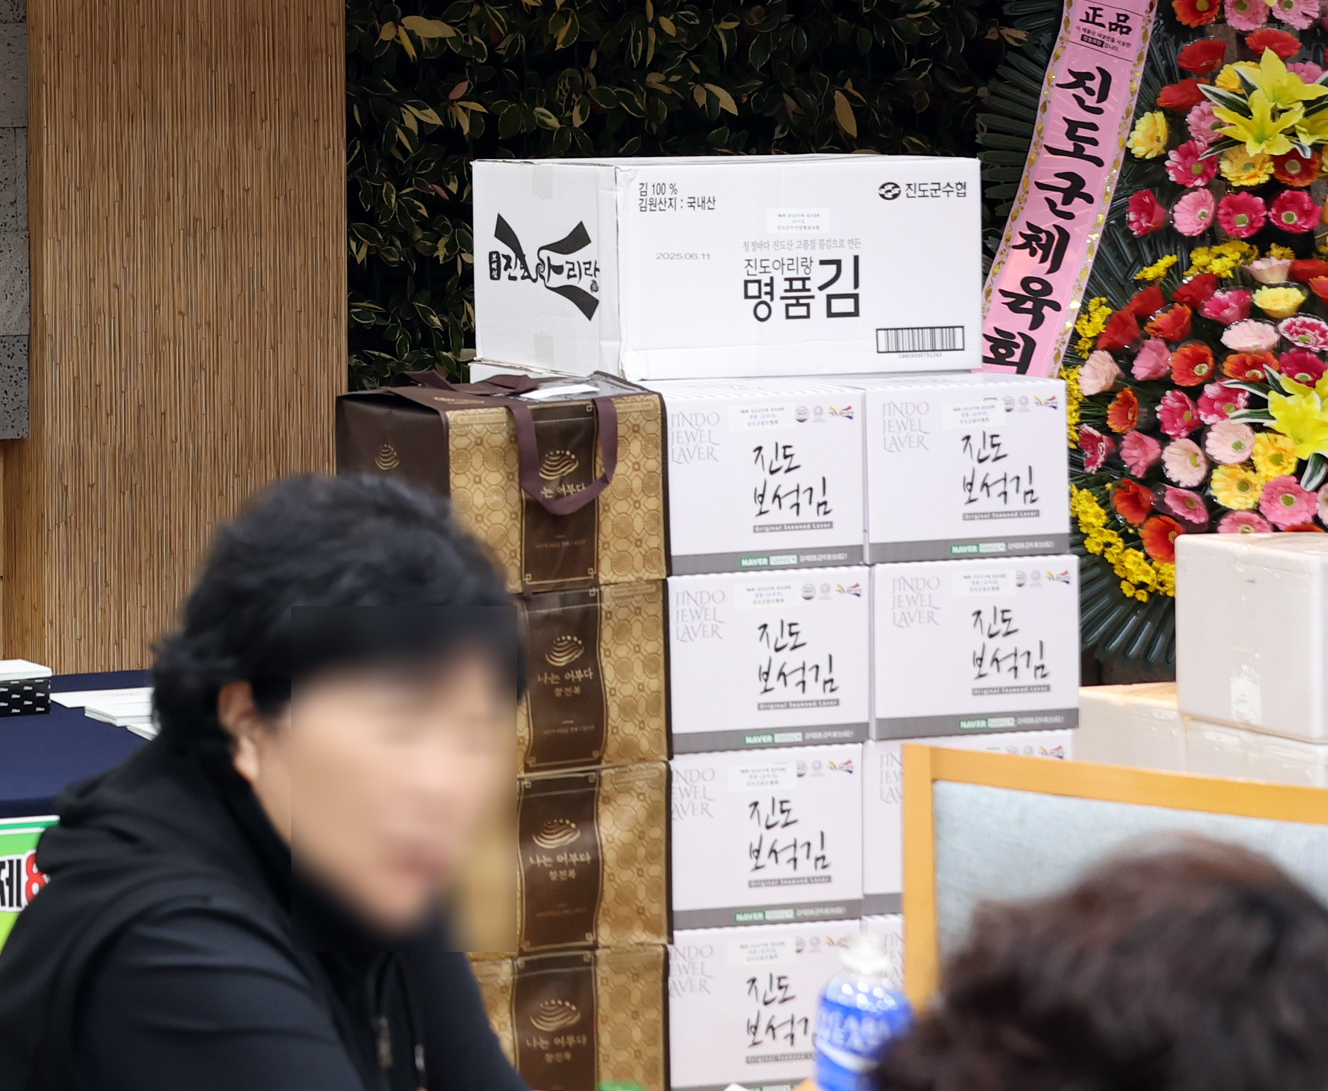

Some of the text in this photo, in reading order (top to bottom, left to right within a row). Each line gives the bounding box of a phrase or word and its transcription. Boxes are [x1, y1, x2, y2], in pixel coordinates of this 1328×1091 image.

[1079, 6, 1133, 36] 正品
[638, 182, 648, 197] 김
[652, 182, 666, 196] 100
[905, 181, 967, 199] 진도군수협
[638, 197, 677, 212] 김원산지
[687, 196, 716, 211] 국내산
[983, 65, 1114, 376] 진도군체육회
[744, 256, 814, 277] 진도아리랑
[881, 400, 930, 419] JINDO
[669, 411, 720, 430] JINDO
[882, 417, 931, 435] JEWEL
[670, 428, 721, 446] JEWEL
[883, 433, 930, 453] LAVER
[961, 430, 1008, 464] 진도
[671, 445, 719, 464] LAVER
[752, 441, 801, 475] 진도
[962, 465, 1039, 505] 보석김
[753, 475, 833, 517] 보석김
[952, 545, 978, 554] NAVER
[741, 557, 769, 567] NAVER
[891, 576, 940, 594] JINDO
[674, 589, 725, 608] JINDO
[892, 592, 941, 610] JEWEL
[675, 606, 726, 624] JEWEL
[893, 608, 940, 628] LAVER
[971, 605, 1019, 639] 진도
[675, 622, 724, 642] LAVER
[757, 619, 807, 653] 진도
[972, 639, 1050, 680] 보석김
[758, 653, 839, 695] 보석김
[960, 720, 987, 729] NAVER
[745, 735, 773, 744] NAVER
[748, 796, 799, 830] 진도
[749, 830, 831, 872] 보석김
[746, 972, 796, 1006] 진도
